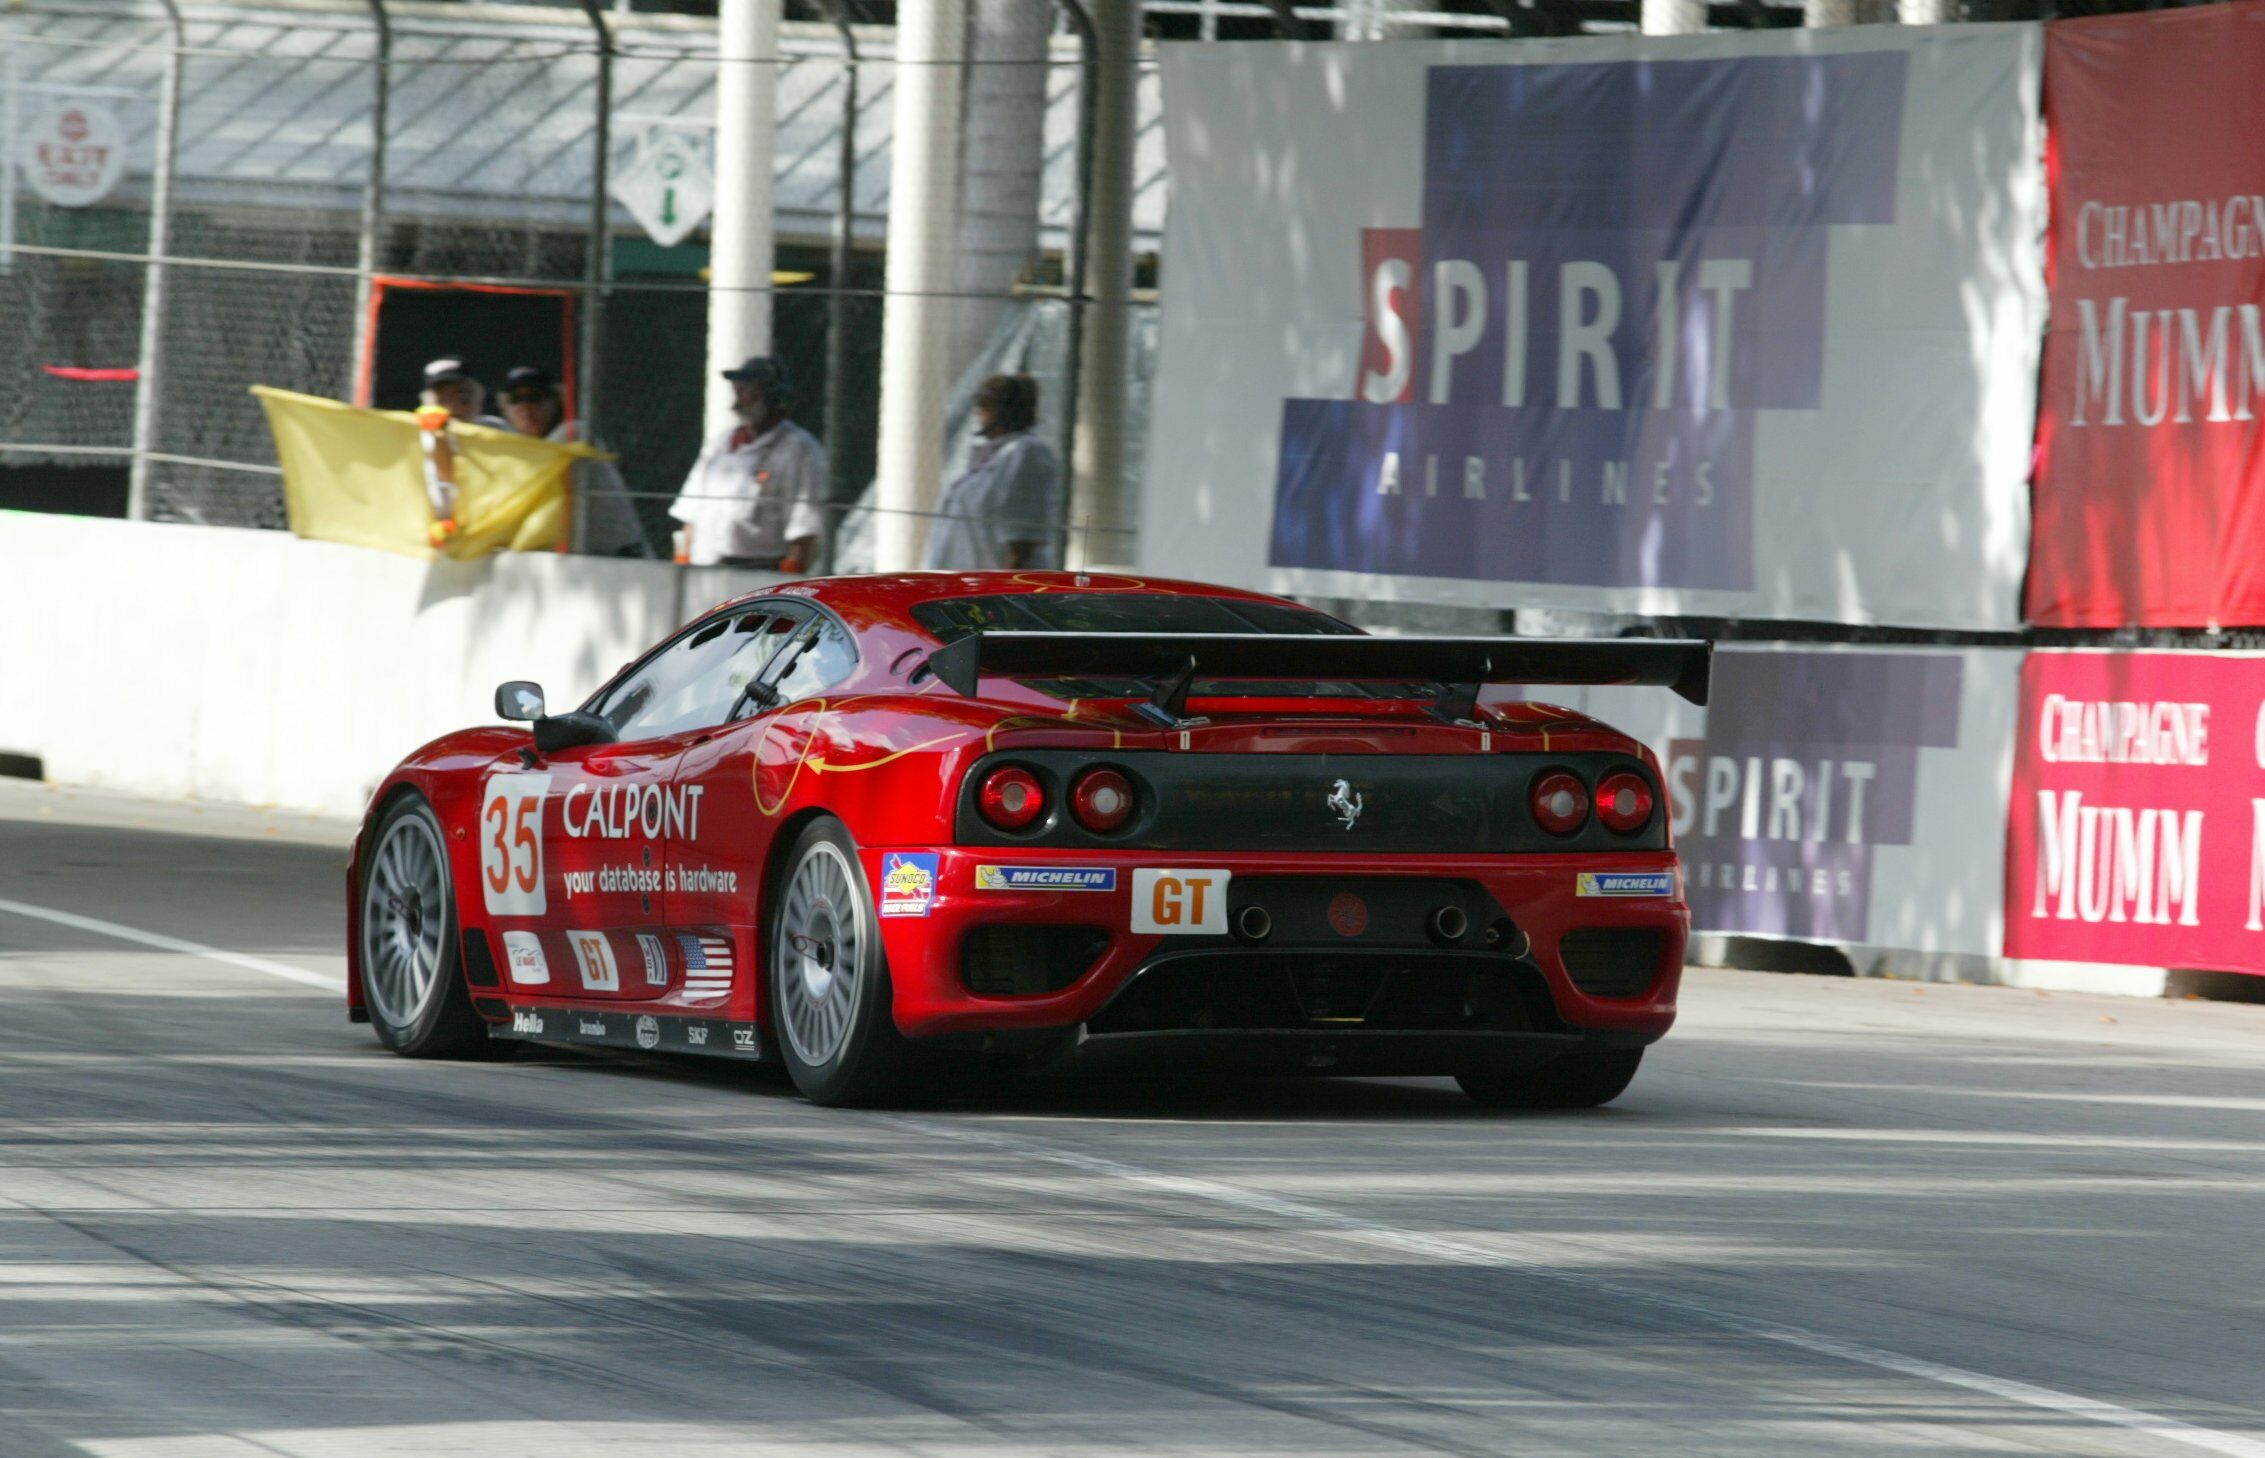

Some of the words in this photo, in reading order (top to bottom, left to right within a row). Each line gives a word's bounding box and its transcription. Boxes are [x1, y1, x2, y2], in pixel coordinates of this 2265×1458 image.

[1363, 258, 1752, 411] SPIRIT
[1377, 452, 1714, 505] AIRLINES
[2040, 693, 2210, 766] CHAMPAGNE
[563, 782, 704, 841] CALPONT
[1670, 755, 1877, 844] SPIRIT
[486, 794, 540, 895] 35
[2031, 789, 2205, 927] MUMM
[564, 871, 595, 899] your
[599, 864, 661, 892] database
[665, 865, 676, 892] is
[679, 864, 737, 894] hardware
[890, 873, 927, 884] SUNOCO
[1011, 871, 1106, 884] MICHELIN
[1603, 878, 1669, 890] MICHELIN
[1152, 877, 1213, 926] GT
[578, 937, 609, 982] GT
[513, 1012, 544, 1034] Hella
[688, 1026, 709, 1045] SKF
[733, 1029, 755, 1045] OZ
